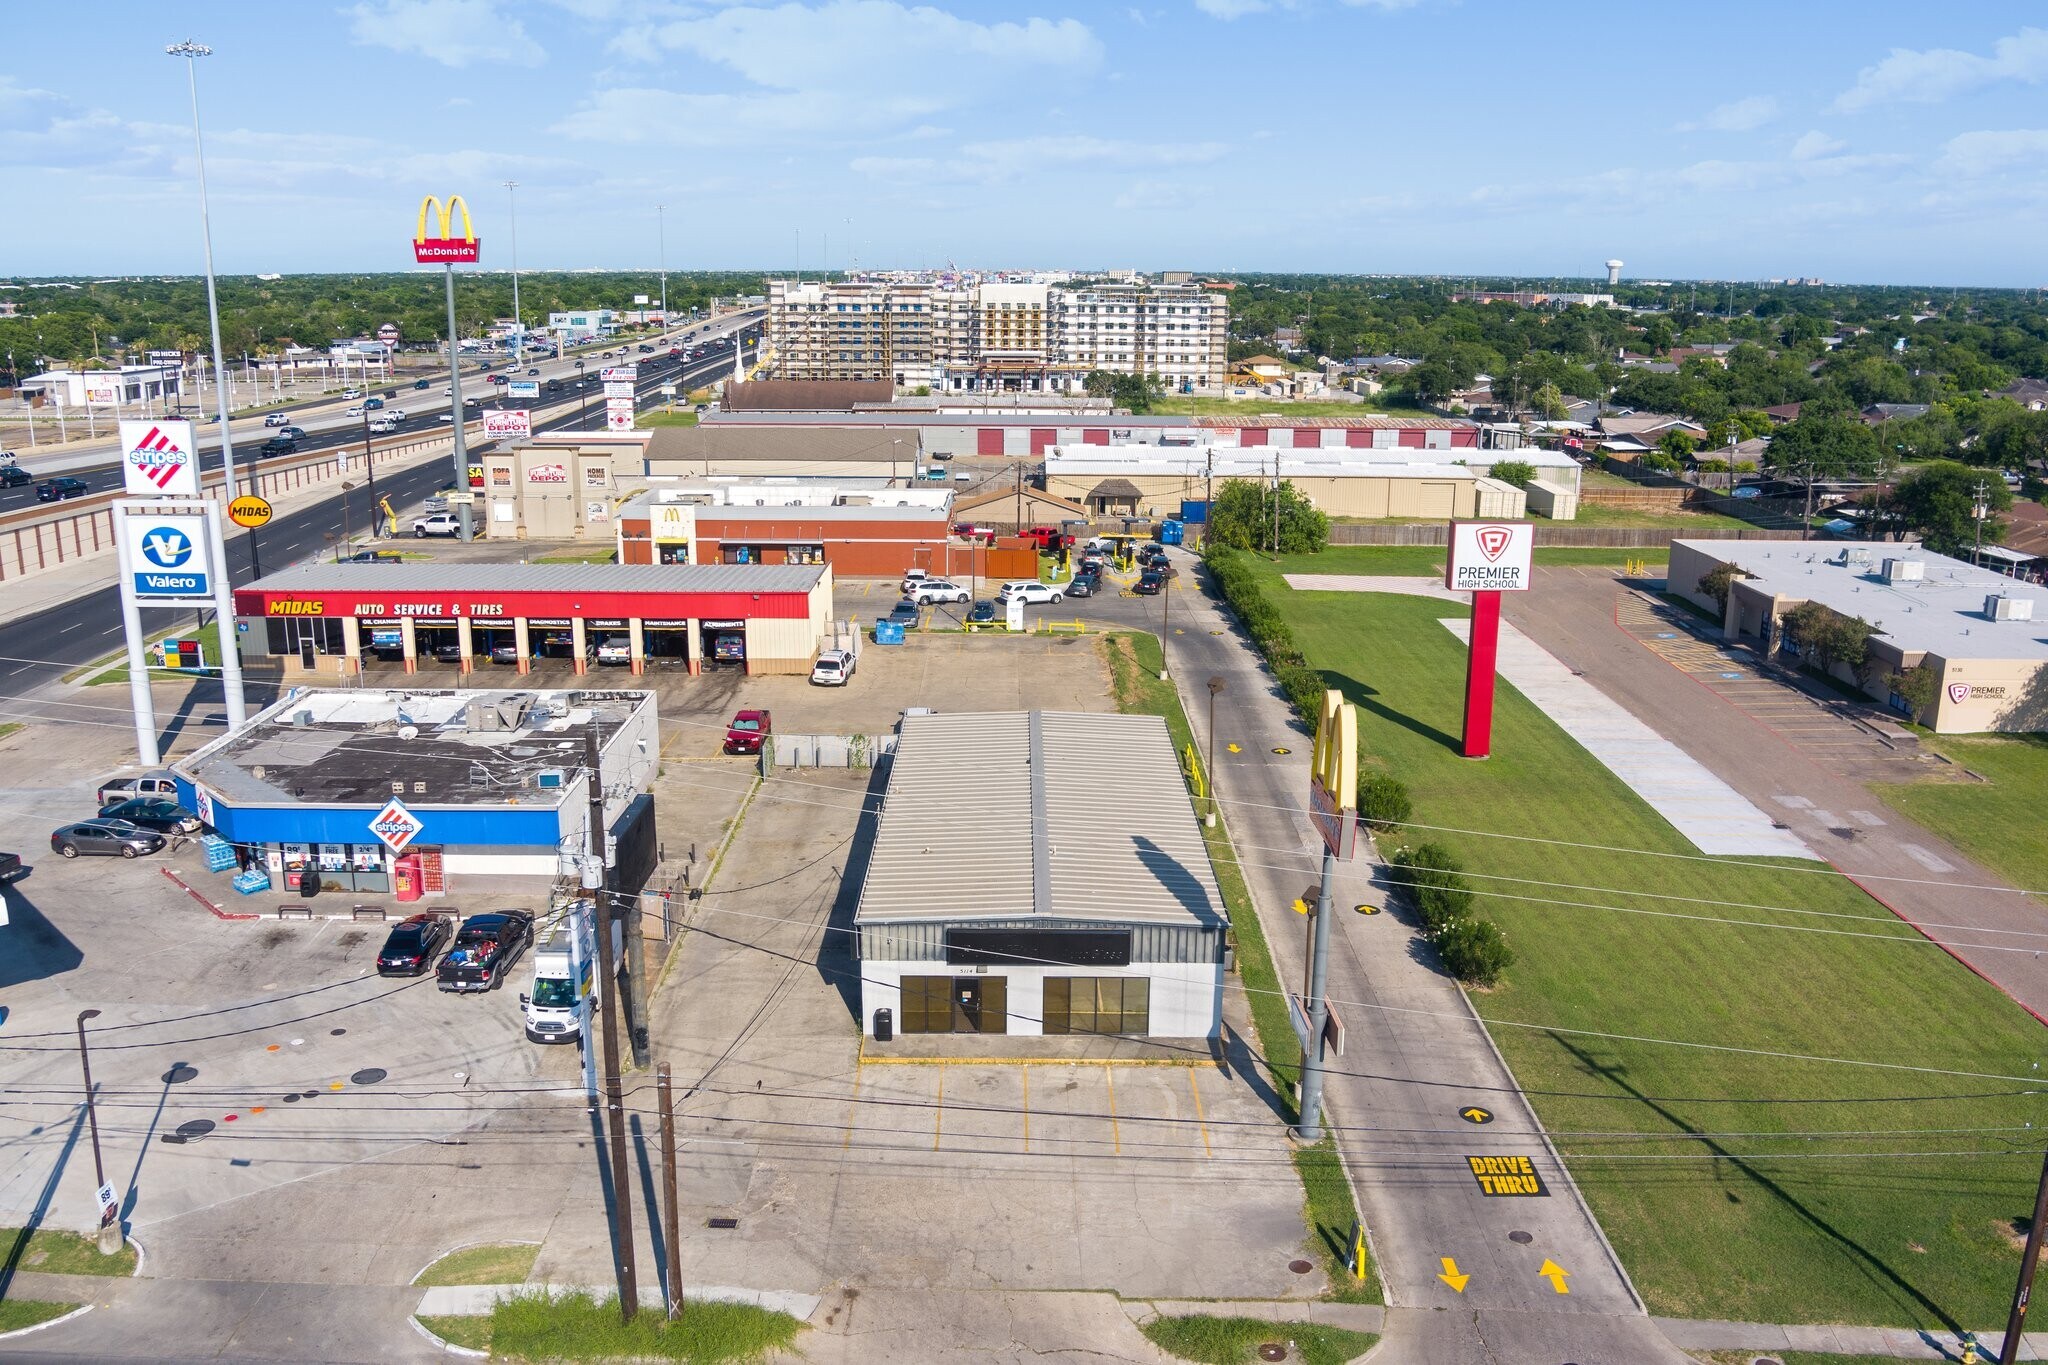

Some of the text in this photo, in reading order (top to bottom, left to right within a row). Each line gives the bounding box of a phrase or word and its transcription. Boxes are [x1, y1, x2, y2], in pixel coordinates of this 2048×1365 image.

[418, 247, 475, 256] McDonald's
[130, 448, 187, 467] stripes
[232, 505, 269, 517] MIDAS
[1458, 566, 1520, 579] PREMIER
[146, 575, 197, 588] Valero
[1457, 579, 1520, 588] HIGH SCHOOL
[270, 598, 324, 615] MIDAS
[354, 603, 504, 616] AUTO SERVICE & TIRES
[1970, 686, 2006, 694] PREMIER
[376, 821, 414, 835] stripes
[1469, 1156, 1533, 1174] DRIVE
[1478, 1175, 1539, 1194] THRU
